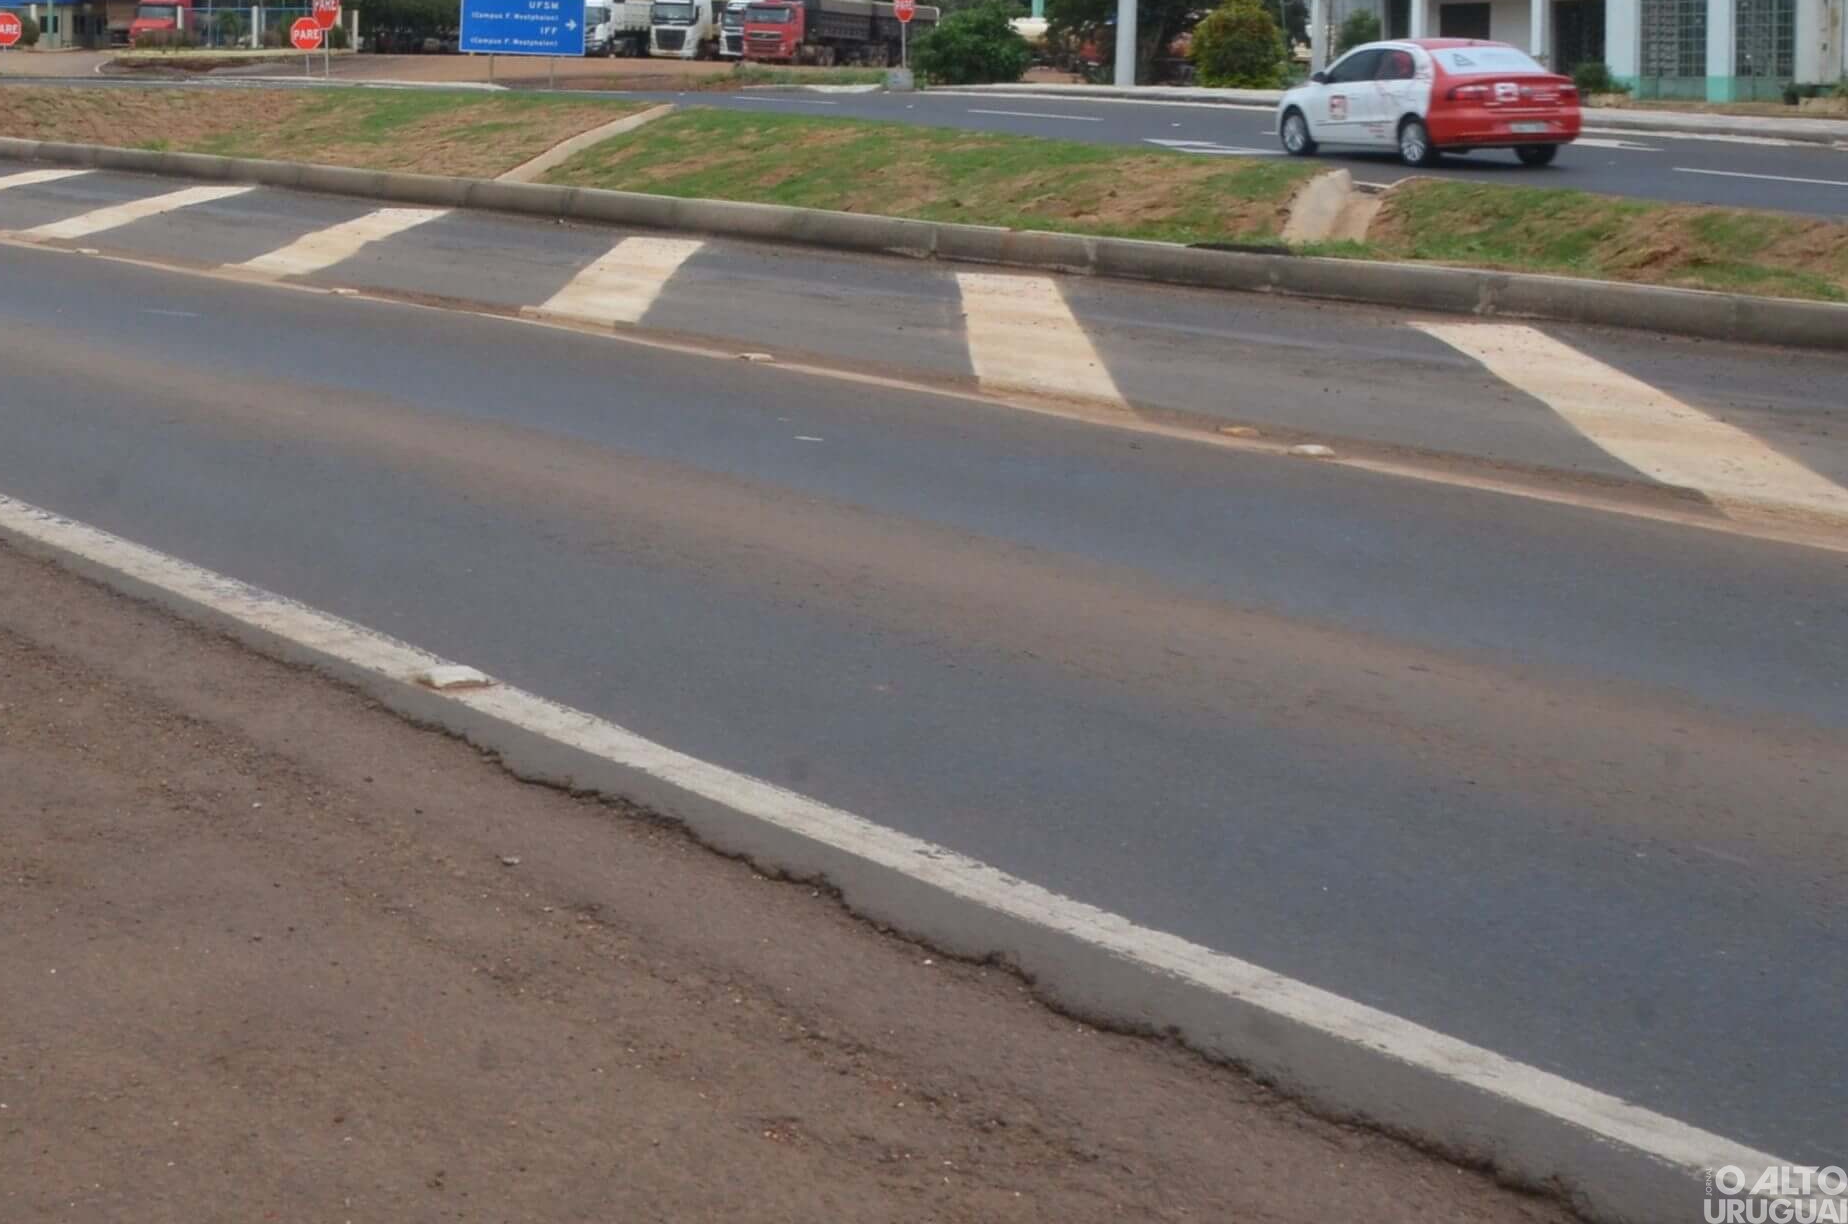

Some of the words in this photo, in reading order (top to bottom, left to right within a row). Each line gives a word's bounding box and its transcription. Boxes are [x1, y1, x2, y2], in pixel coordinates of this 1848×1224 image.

[529, 0, 559, 10] UFSM
[895, 0, 913, 10] PARE
[294, 29, 320, 40] PARE
